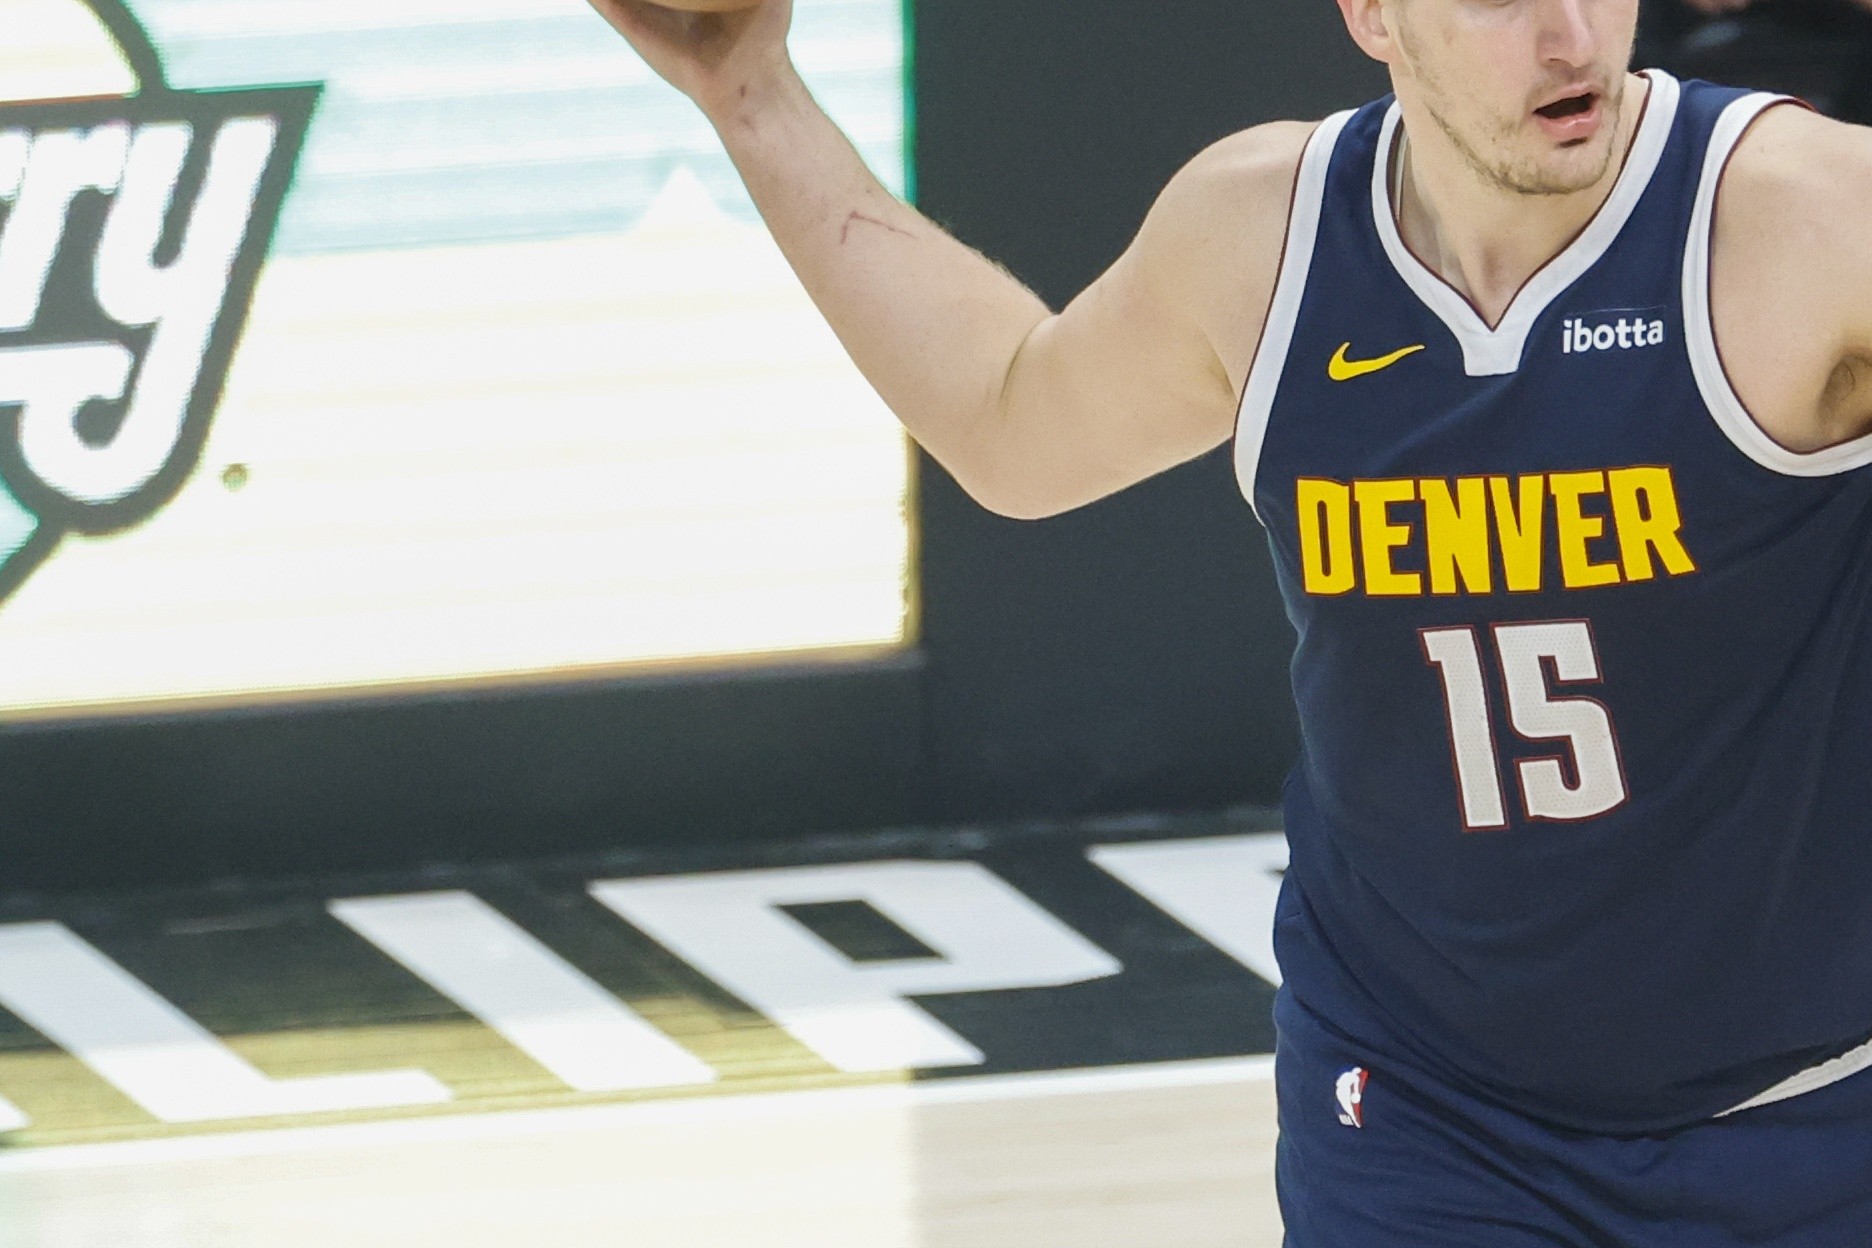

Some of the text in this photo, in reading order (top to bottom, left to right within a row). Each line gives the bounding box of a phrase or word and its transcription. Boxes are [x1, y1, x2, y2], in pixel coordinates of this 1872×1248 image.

[0, 114, 280, 508] ry
[1562, 316, 1665, 354] ibotta
[1296, 464, 1698, 597] DENVER
[1416, 617, 1629, 832] 15
